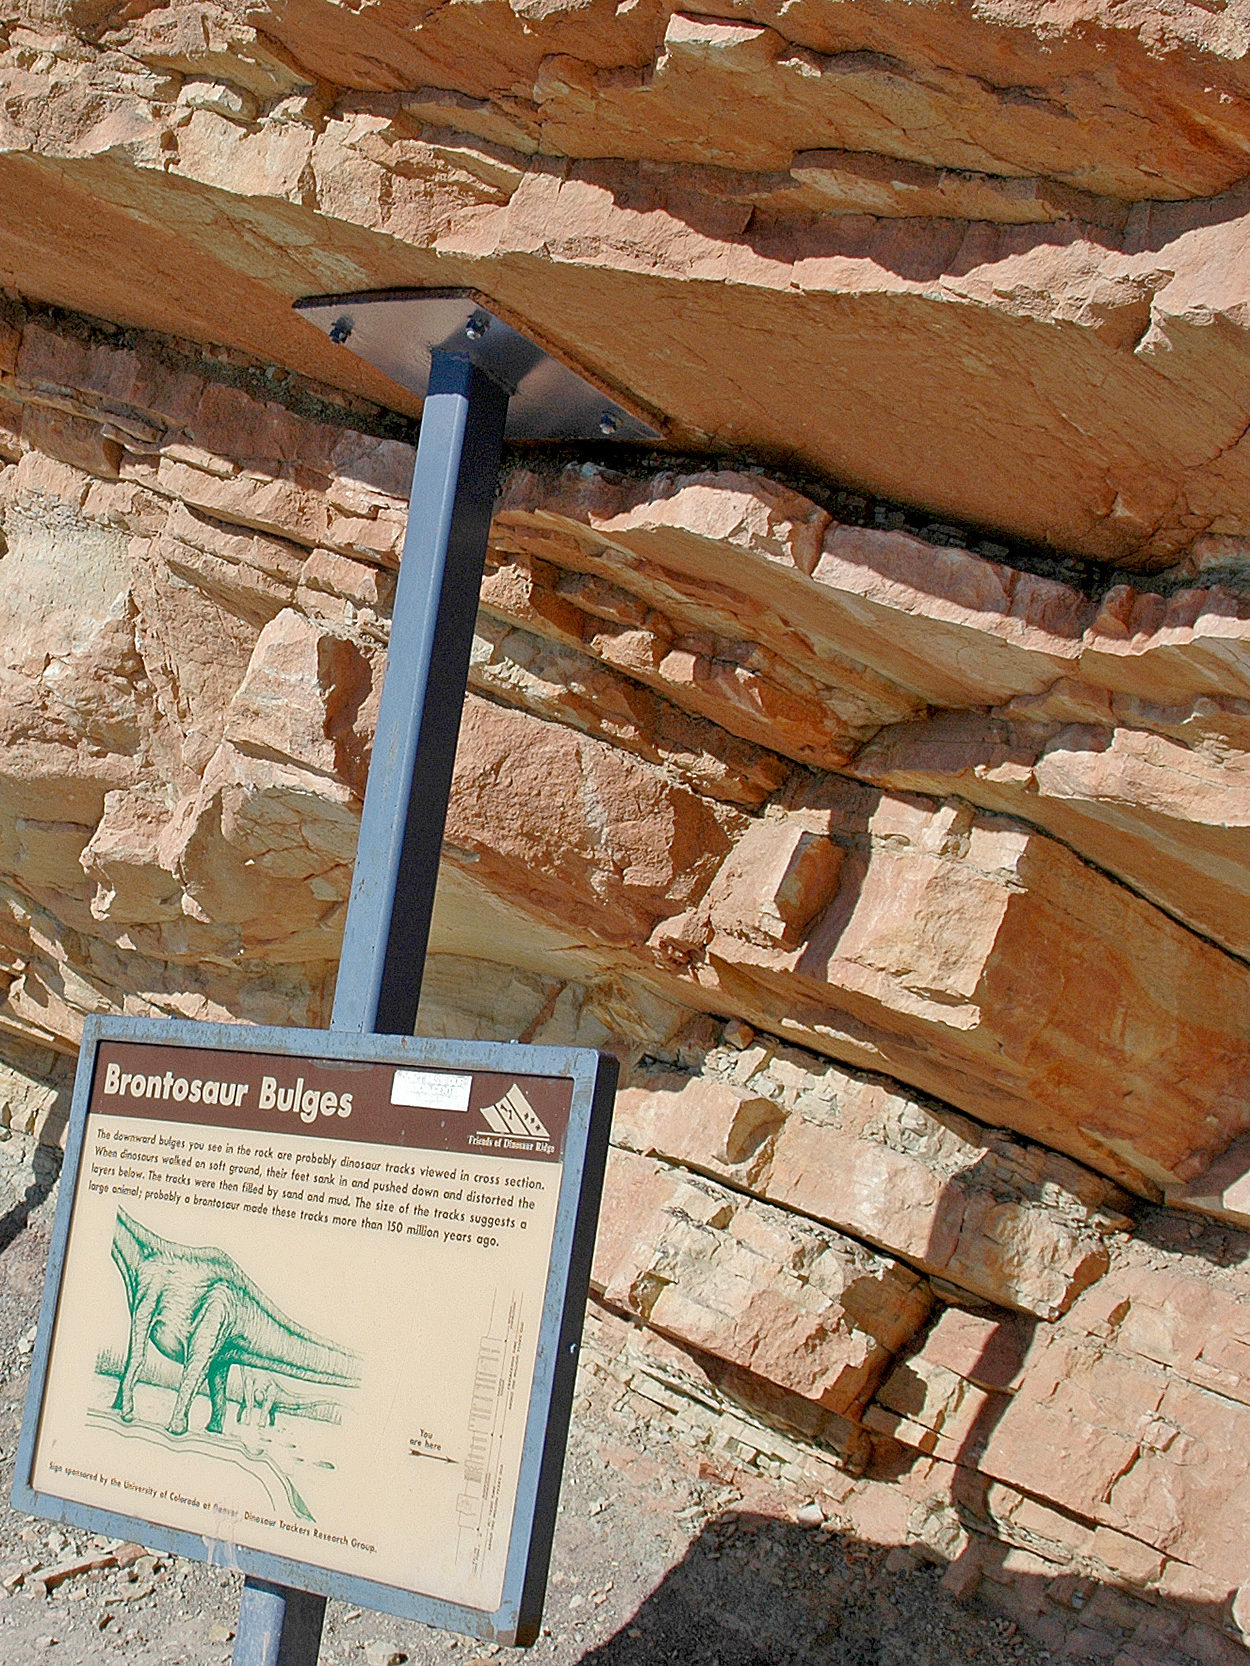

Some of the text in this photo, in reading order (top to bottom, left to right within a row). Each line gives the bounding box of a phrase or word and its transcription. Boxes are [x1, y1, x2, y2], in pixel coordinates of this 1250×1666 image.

[104, 1062, 353, 1123] Brontosaur Bulges
[97, 1129, 545, 1190] The downward bulges you see in the rock are probably dinosaur tracks viewed in cross section.
[468, 1135, 555, 1154] Friends of Dinosaur Ridge
[91, 1163, 527, 1229] layers below. The tracks were then filled by sand and mud. The size of the tracks suggests a
[95, 1146, 535, 1209] When dinosaurs walked on soft ground, their feet sank in and pushed down and distorted the
[88, 1181, 499, 1248] large animal; probably a brontosaur made these tracks more than 150 million years ago.
[420, 1428, 433, 1439] You
[425, 1440, 441, 1450] here
[49, 1461, 62, 1473] Sign
[65, 1466, 97, 1483] sponsored
[99, 1474, 107, 1486] by
[110, 1476, 122, 1488] the
[123, 1479, 157, 1497] University
[160, 1489, 168, 1500] of
[169, 1492, 200, 1508] Colorado
[203, 1500, 211, 1510] at
[244, 1511, 276, 1527] Dinosaur
[279, 1519, 310, 1537] Trackers
[313, 1528, 349, 1546] Research
[351, 1537, 377, 1553] Group.
